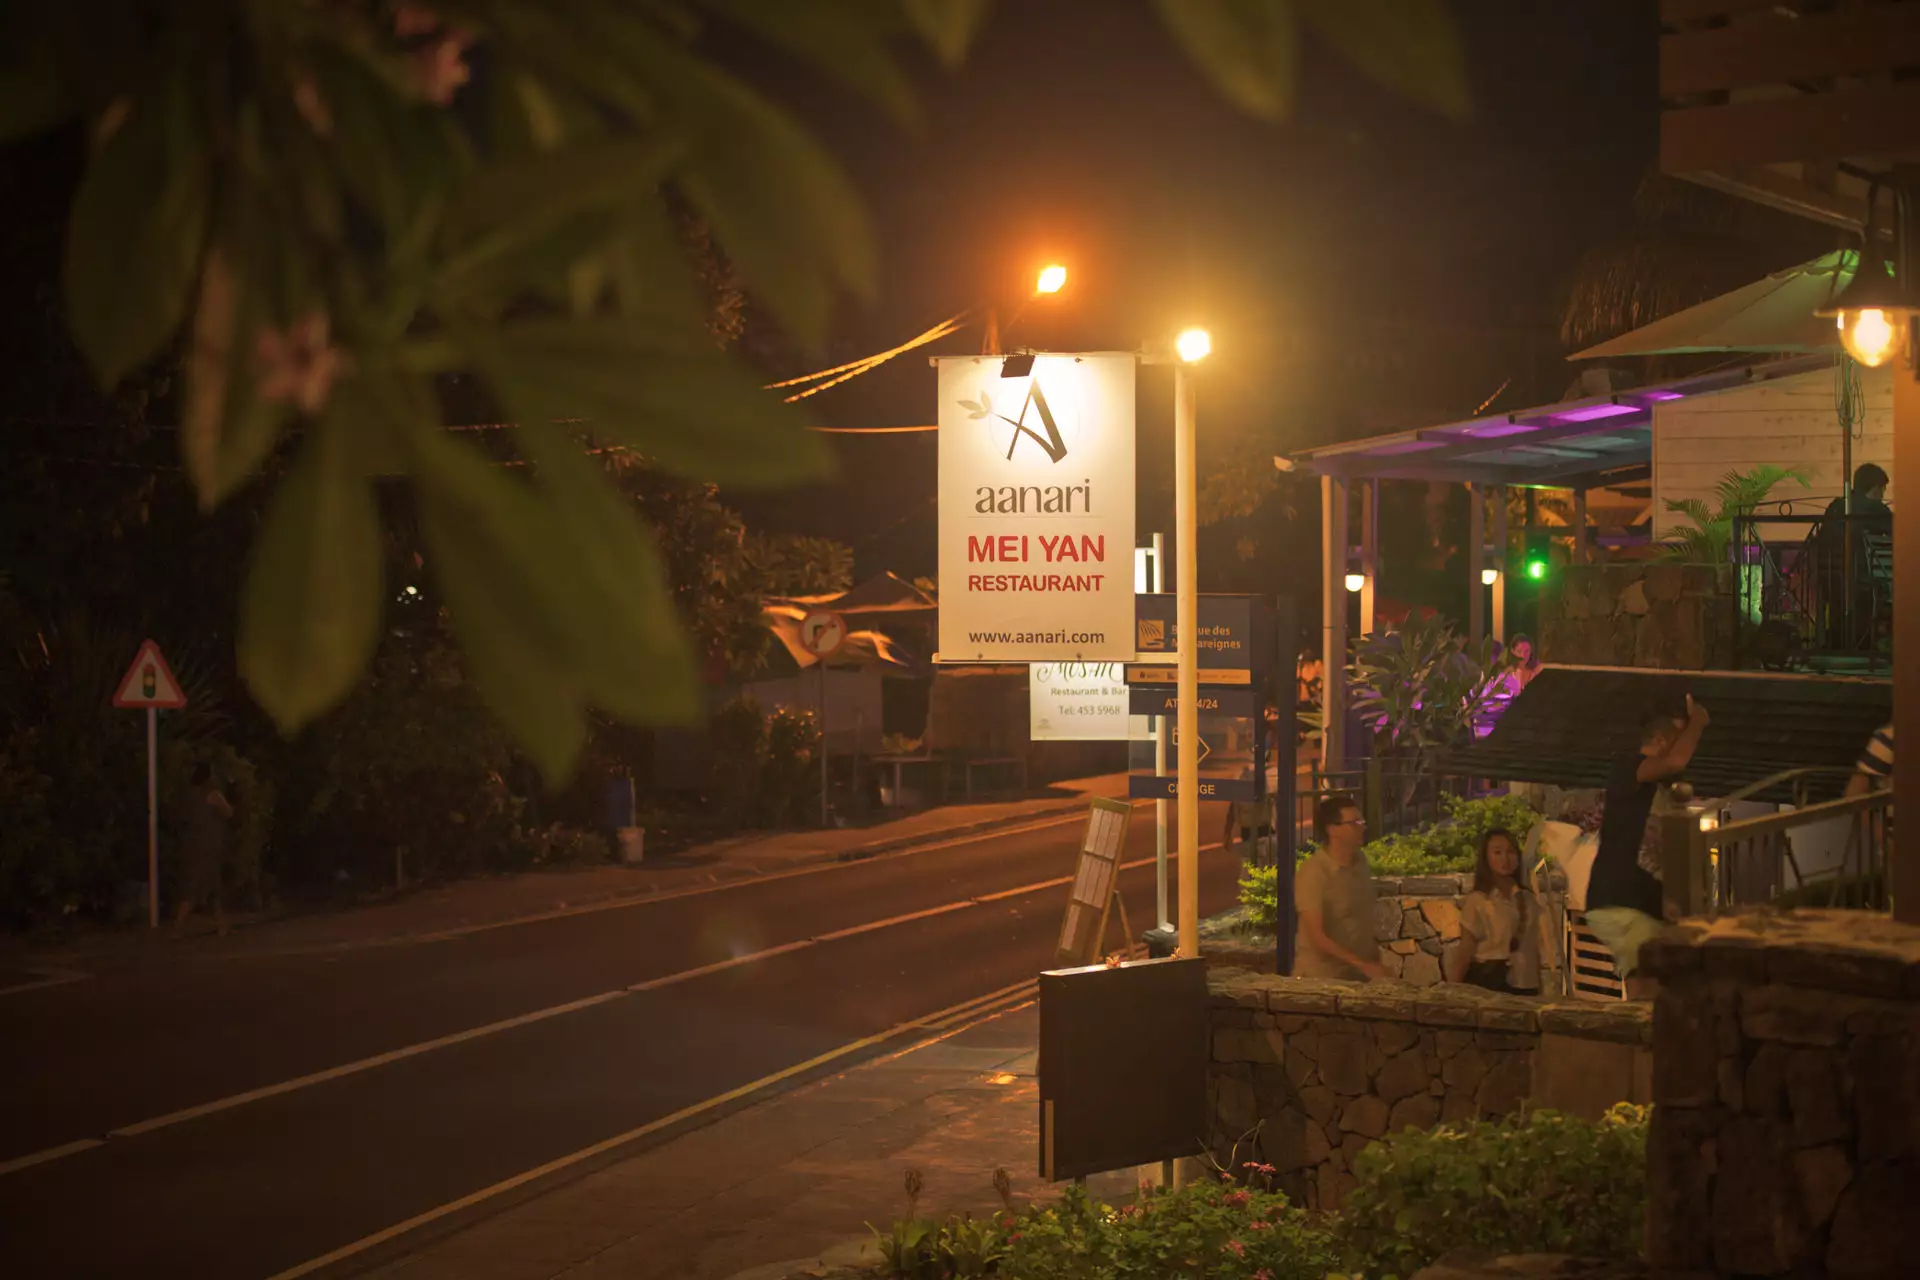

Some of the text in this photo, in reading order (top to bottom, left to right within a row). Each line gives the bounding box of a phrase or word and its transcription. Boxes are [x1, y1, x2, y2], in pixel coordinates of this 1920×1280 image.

[975, 479, 1090, 513] aanari
[968, 535, 1105, 562] MEI YAN
[968, 575, 1105, 592] RESTAURANT
[1213, 625, 1231, 636] des
[969, 630, 1105, 644] www.aanari.com
[1051, 687, 1127, 696] Restaurant & Bar
[1164, 698, 1178, 708] AT
[1077, 705, 1094, 716] 453
[1097, 705, 1120, 716] 5968
